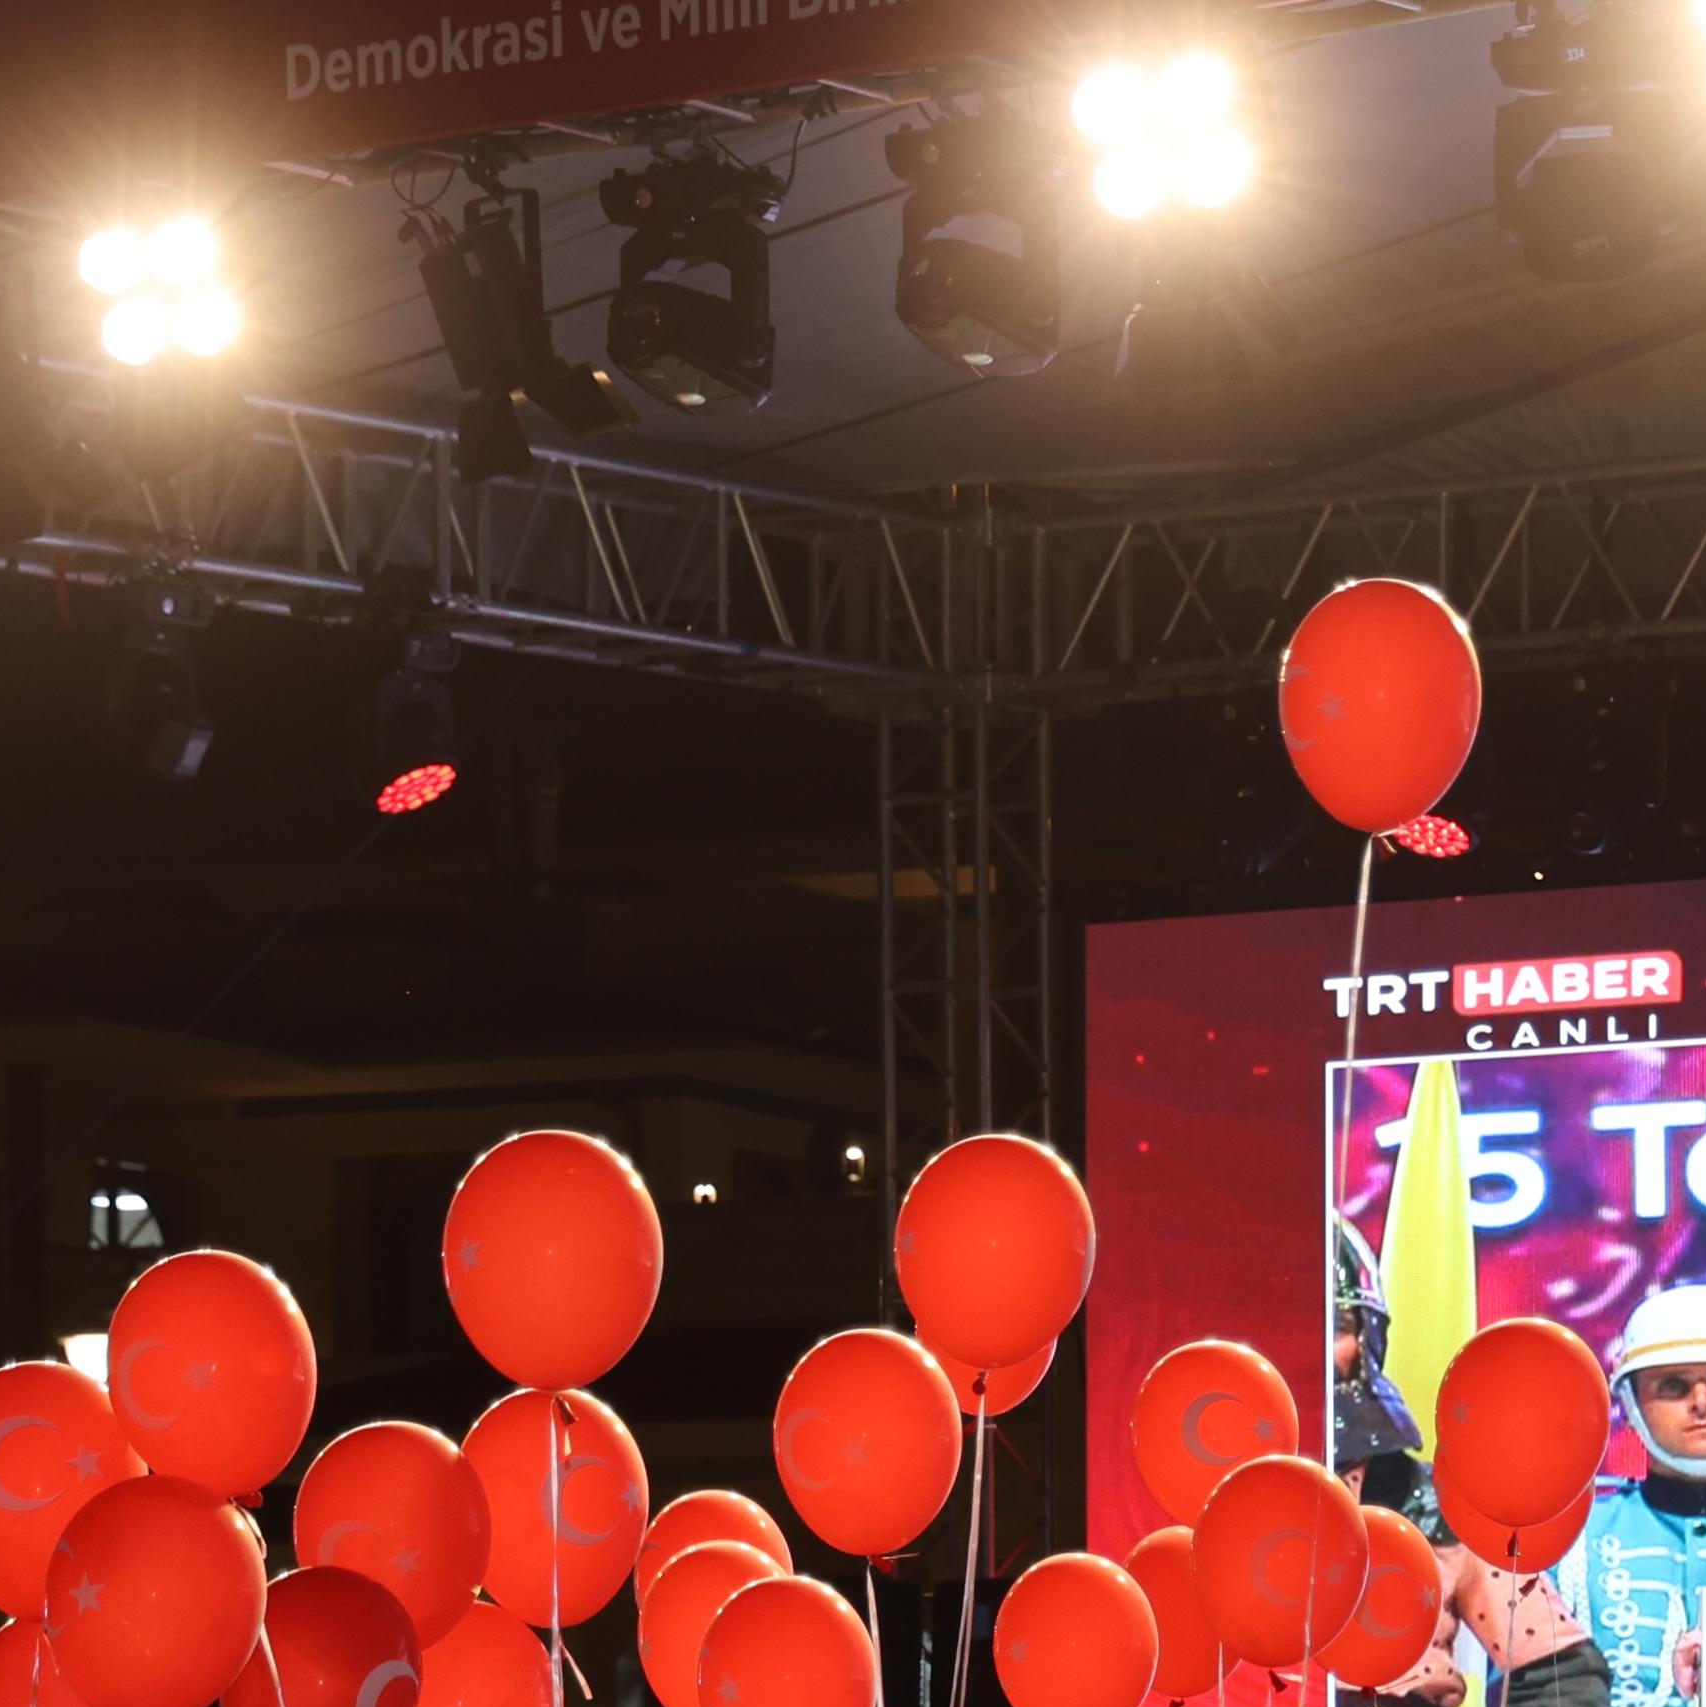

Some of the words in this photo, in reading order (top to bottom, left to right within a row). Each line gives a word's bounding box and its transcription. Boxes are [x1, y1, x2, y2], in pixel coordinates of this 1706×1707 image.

[286, 0, 563, 100] Demokrasi
[581, 3, 641, 52] ve
[1323, 970, 1449, 1017] TRT
[1463, 956, 1670, 1009] HABER
[1466, 1014, 1657, 1050] CANLI
